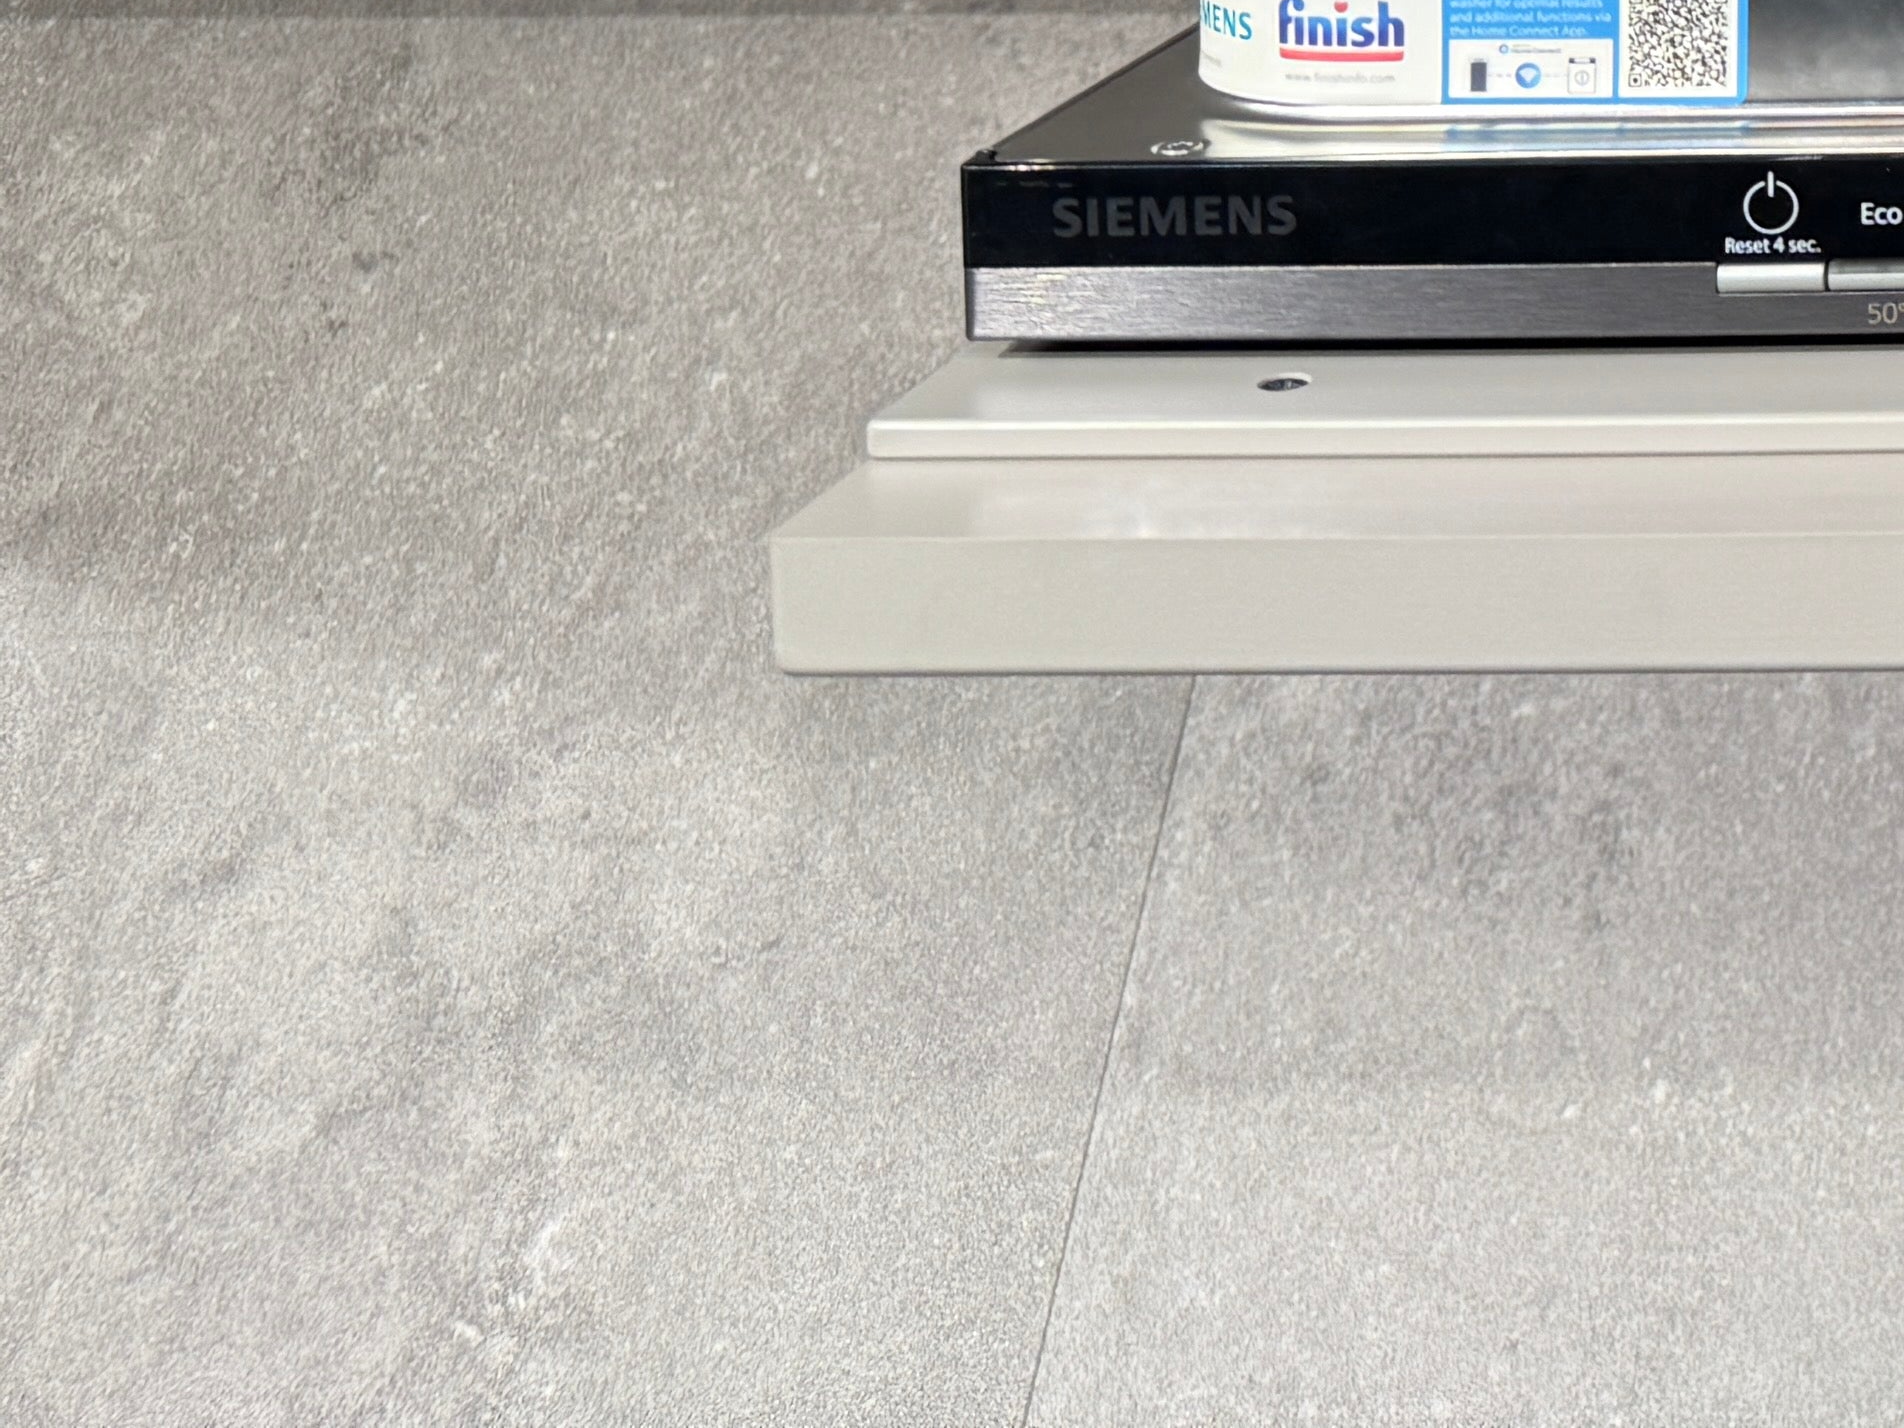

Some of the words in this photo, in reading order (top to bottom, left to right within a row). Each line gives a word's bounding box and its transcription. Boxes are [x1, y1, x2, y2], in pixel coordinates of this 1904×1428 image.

[1450, 11, 1473, 23] and
[1474, 10, 1534, 23] additional
[1536, 10, 1594, 22] functions
[1595, 11, 1612, 23] via
[1450, 25, 1471, 36] the
[1472, 25, 1508, 36] Home
[1509, 24, 1559, 37] Connect
[1560, 24, 1588, 38] App.
[1051, 194, 1298, 239] SIEMENS
[1859, 201, 1904, 225] Eco
[1723, 236, 1770, 255] Reset
[1771, 235, 1786, 254] 4
[1788, 236, 1822, 254] sec.
